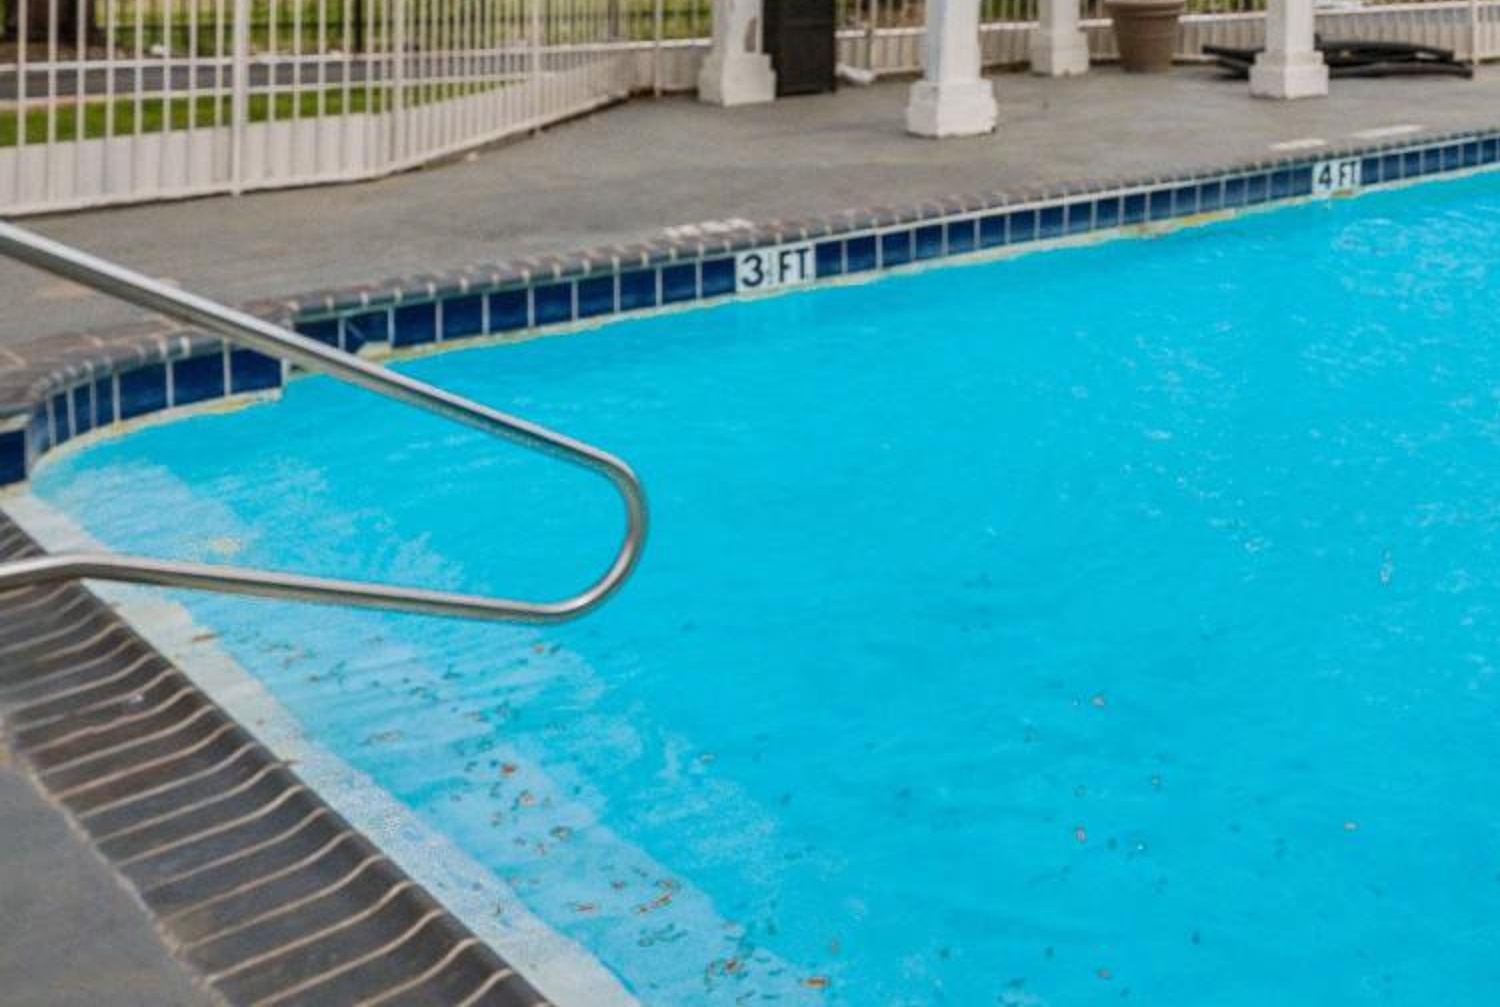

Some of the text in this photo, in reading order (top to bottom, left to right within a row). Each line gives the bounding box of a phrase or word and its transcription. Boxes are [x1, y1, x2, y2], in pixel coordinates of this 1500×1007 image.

[1318, 160, 1360, 190] 4 FT
[741, 247, 812, 287] 3 FT
